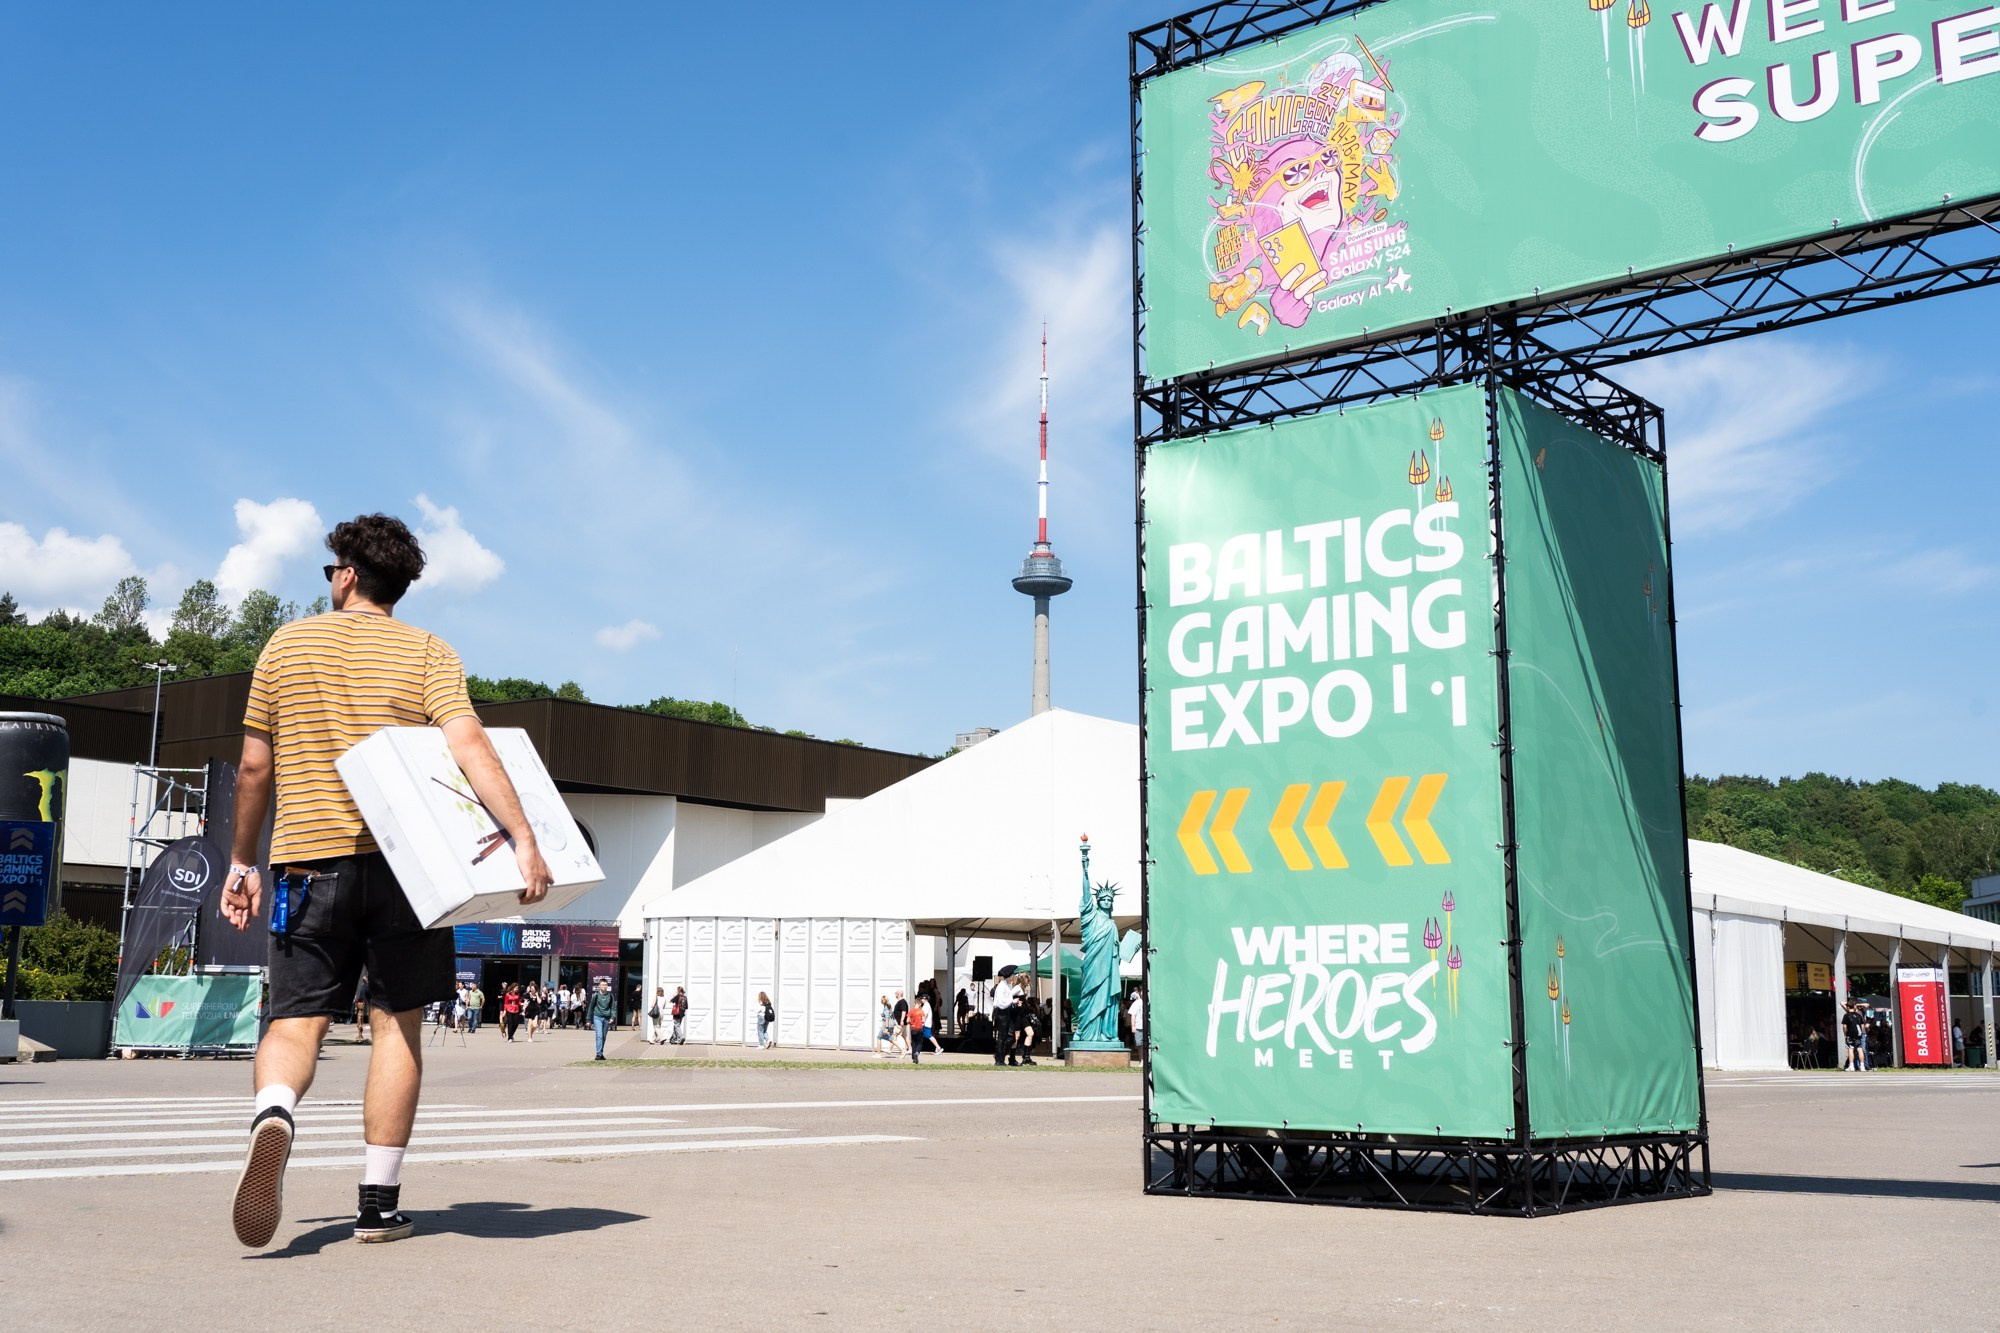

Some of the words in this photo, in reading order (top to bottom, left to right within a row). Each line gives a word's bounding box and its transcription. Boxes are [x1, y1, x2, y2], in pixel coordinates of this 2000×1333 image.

[1317, 82, 1346, 108] 24
[1226, 95, 1307, 168] COMIC
[1303, 96, 1336, 125] CON
[1301, 119, 1330, 138] BALTICS
[1331, 121, 1360, 157] 24-26
[1343, 162, 1361, 203] MAY
[1328, 228, 1406, 266] SAMSUNG
[1347, 227, 1376, 243] Powered
[1376, 224, 1385, 233] by
[1329, 253, 1383, 280] Galaxy
[1385, 242, 1411, 262] S24
[1316, 289, 1365, 313] Galaxy
[1368, 283, 1382, 299] AI
[1168, 501, 1464, 607] BALTICS
[1168, 579, 1466, 678] GAMING
[1170, 669, 1373, 751] EXPO
[0, 874, 28, 885] XPO
[174, 868, 201, 885] SDI
[521, 935, 551, 943] GAMING
[521, 941, 542, 949] EXPO
[522, 929, 551, 937] BALTICS
[1231, 923, 1410, 966] WHERE
[1206, 957, 1440, 1058] HEROES
[1254, 1048, 1394, 1070] MEET
